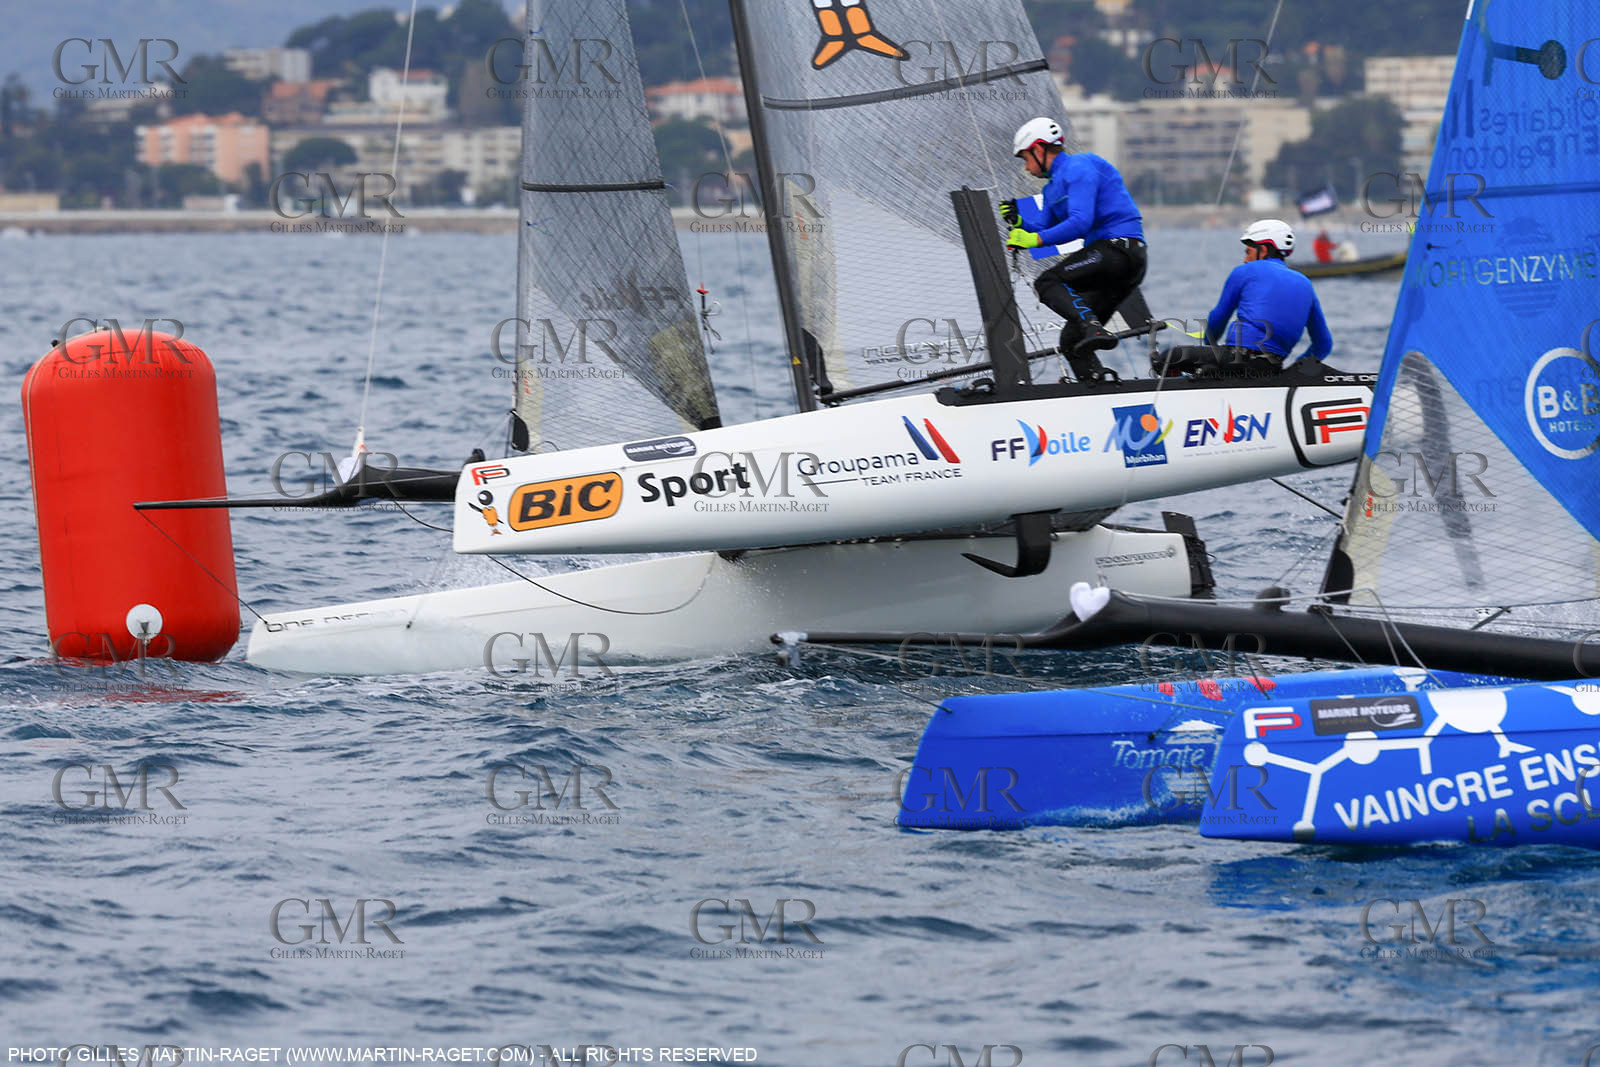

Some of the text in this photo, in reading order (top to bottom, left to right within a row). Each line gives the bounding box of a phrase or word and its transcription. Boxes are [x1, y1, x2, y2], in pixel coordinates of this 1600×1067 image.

[797, 451, 919, 476] Groupama
[637, 462, 751, 507] Sport
[862, 468, 963, 486] TEAM FRANCE
[1317, 704, 1412, 719] MARINE MOTEURS
[1333, 764, 1514, 831] VAINCRE
[1519, 742, 1600, 792] ENS
